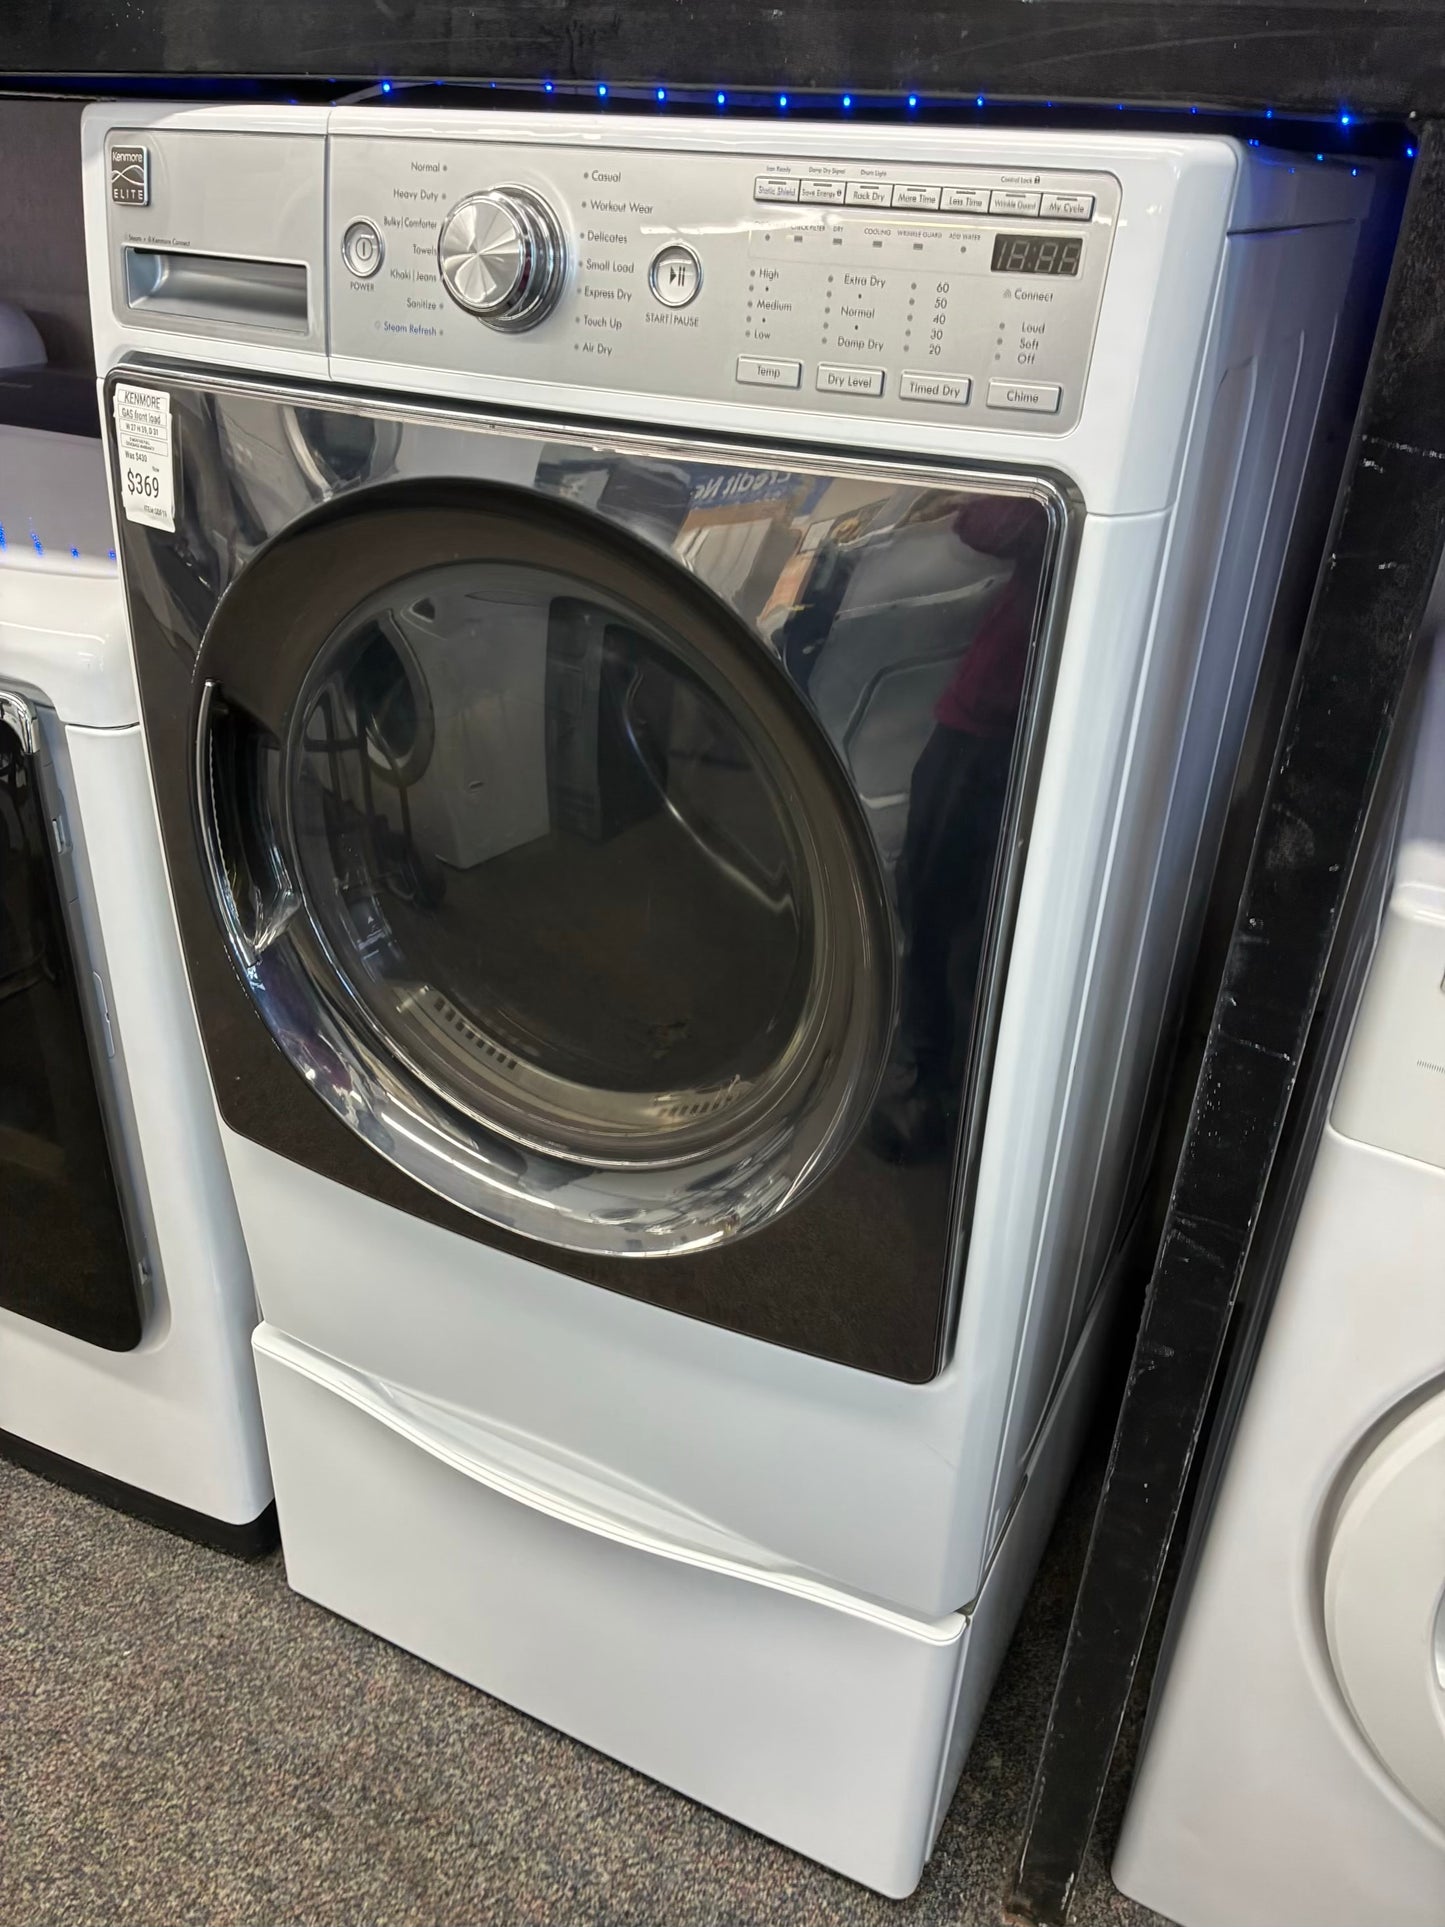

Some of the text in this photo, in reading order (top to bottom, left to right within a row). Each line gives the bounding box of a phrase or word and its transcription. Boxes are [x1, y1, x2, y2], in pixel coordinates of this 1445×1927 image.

[112, 151, 143, 163] Kenmore
[411, 161, 441, 172] Normal
[823, 167, 832, 175] Dry
[591, 171, 622, 183] Casual
[876, 169, 887, 177] Light
[1001, 175, 1019, 184] Control
[114, 188, 144, 200] ELITE
[393, 189, 439, 202] Heavy Duty
[758, 186, 796, 197] Static Shield
[802, 188, 836, 199] Save Energy
[853, 191, 885, 202] Rack Dry
[898, 194, 936, 204] More Time
[949, 197, 983, 207] Less Time
[995, 199, 1037, 210] Wrinkle Guard
[590, 200, 653, 214] Workout Wear
[1049, 203, 1085, 214] My Cycle
[587, 231, 628, 244] Delicates
[864, 228, 892, 236] COOLING
[962, 233, 981, 241] WATER
[412, 244, 438, 256] Towels
[586, 258, 635, 274] Small Load
[759, 269, 779, 281] High
[844, 273, 886, 289] Extra Dry
[350, 281, 375, 292] POWER
[936, 281, 950, 293] 60
[584, 287, 632, 302] Express Dry
[1014, 289, 1054, 303] Connect
[406, 298, 437, 311] Sanitize
[757, 300, 792, 312] Medium
[934, 298, 948, 309] 50
[840, 306, 875, 319] Normal
[584, 315, 623, 330] Touch Up
[932, 313, 946, 325] 40
[384, 322, 437, 337] Steam Refresh
[1021, 322, 1046, 334] Loud
[754, 329, 771, 341] Low
[930, 329, 944, 341] 30
[582, 342, 613, 356] Air Dry
[837, 336, 884, 352] Damp Dry
[928, 344, 942, 356] 20
[1019, 338, 1040, 351] Soft
[1017, 353, 1036, 365] Off
[757, 365, 781, 379] Temp
[828, 375, 872, 389] Dry Level
[910, 383, 961, 399] Timed Dry
[1006, 390, 1039, 404] Chime
[125, 391, 161, 410] KENMORE
[121, 408, 161, 425] GAS front load
[125, 450, 135, 460] Was
[127, 467, 159, 499] $369
